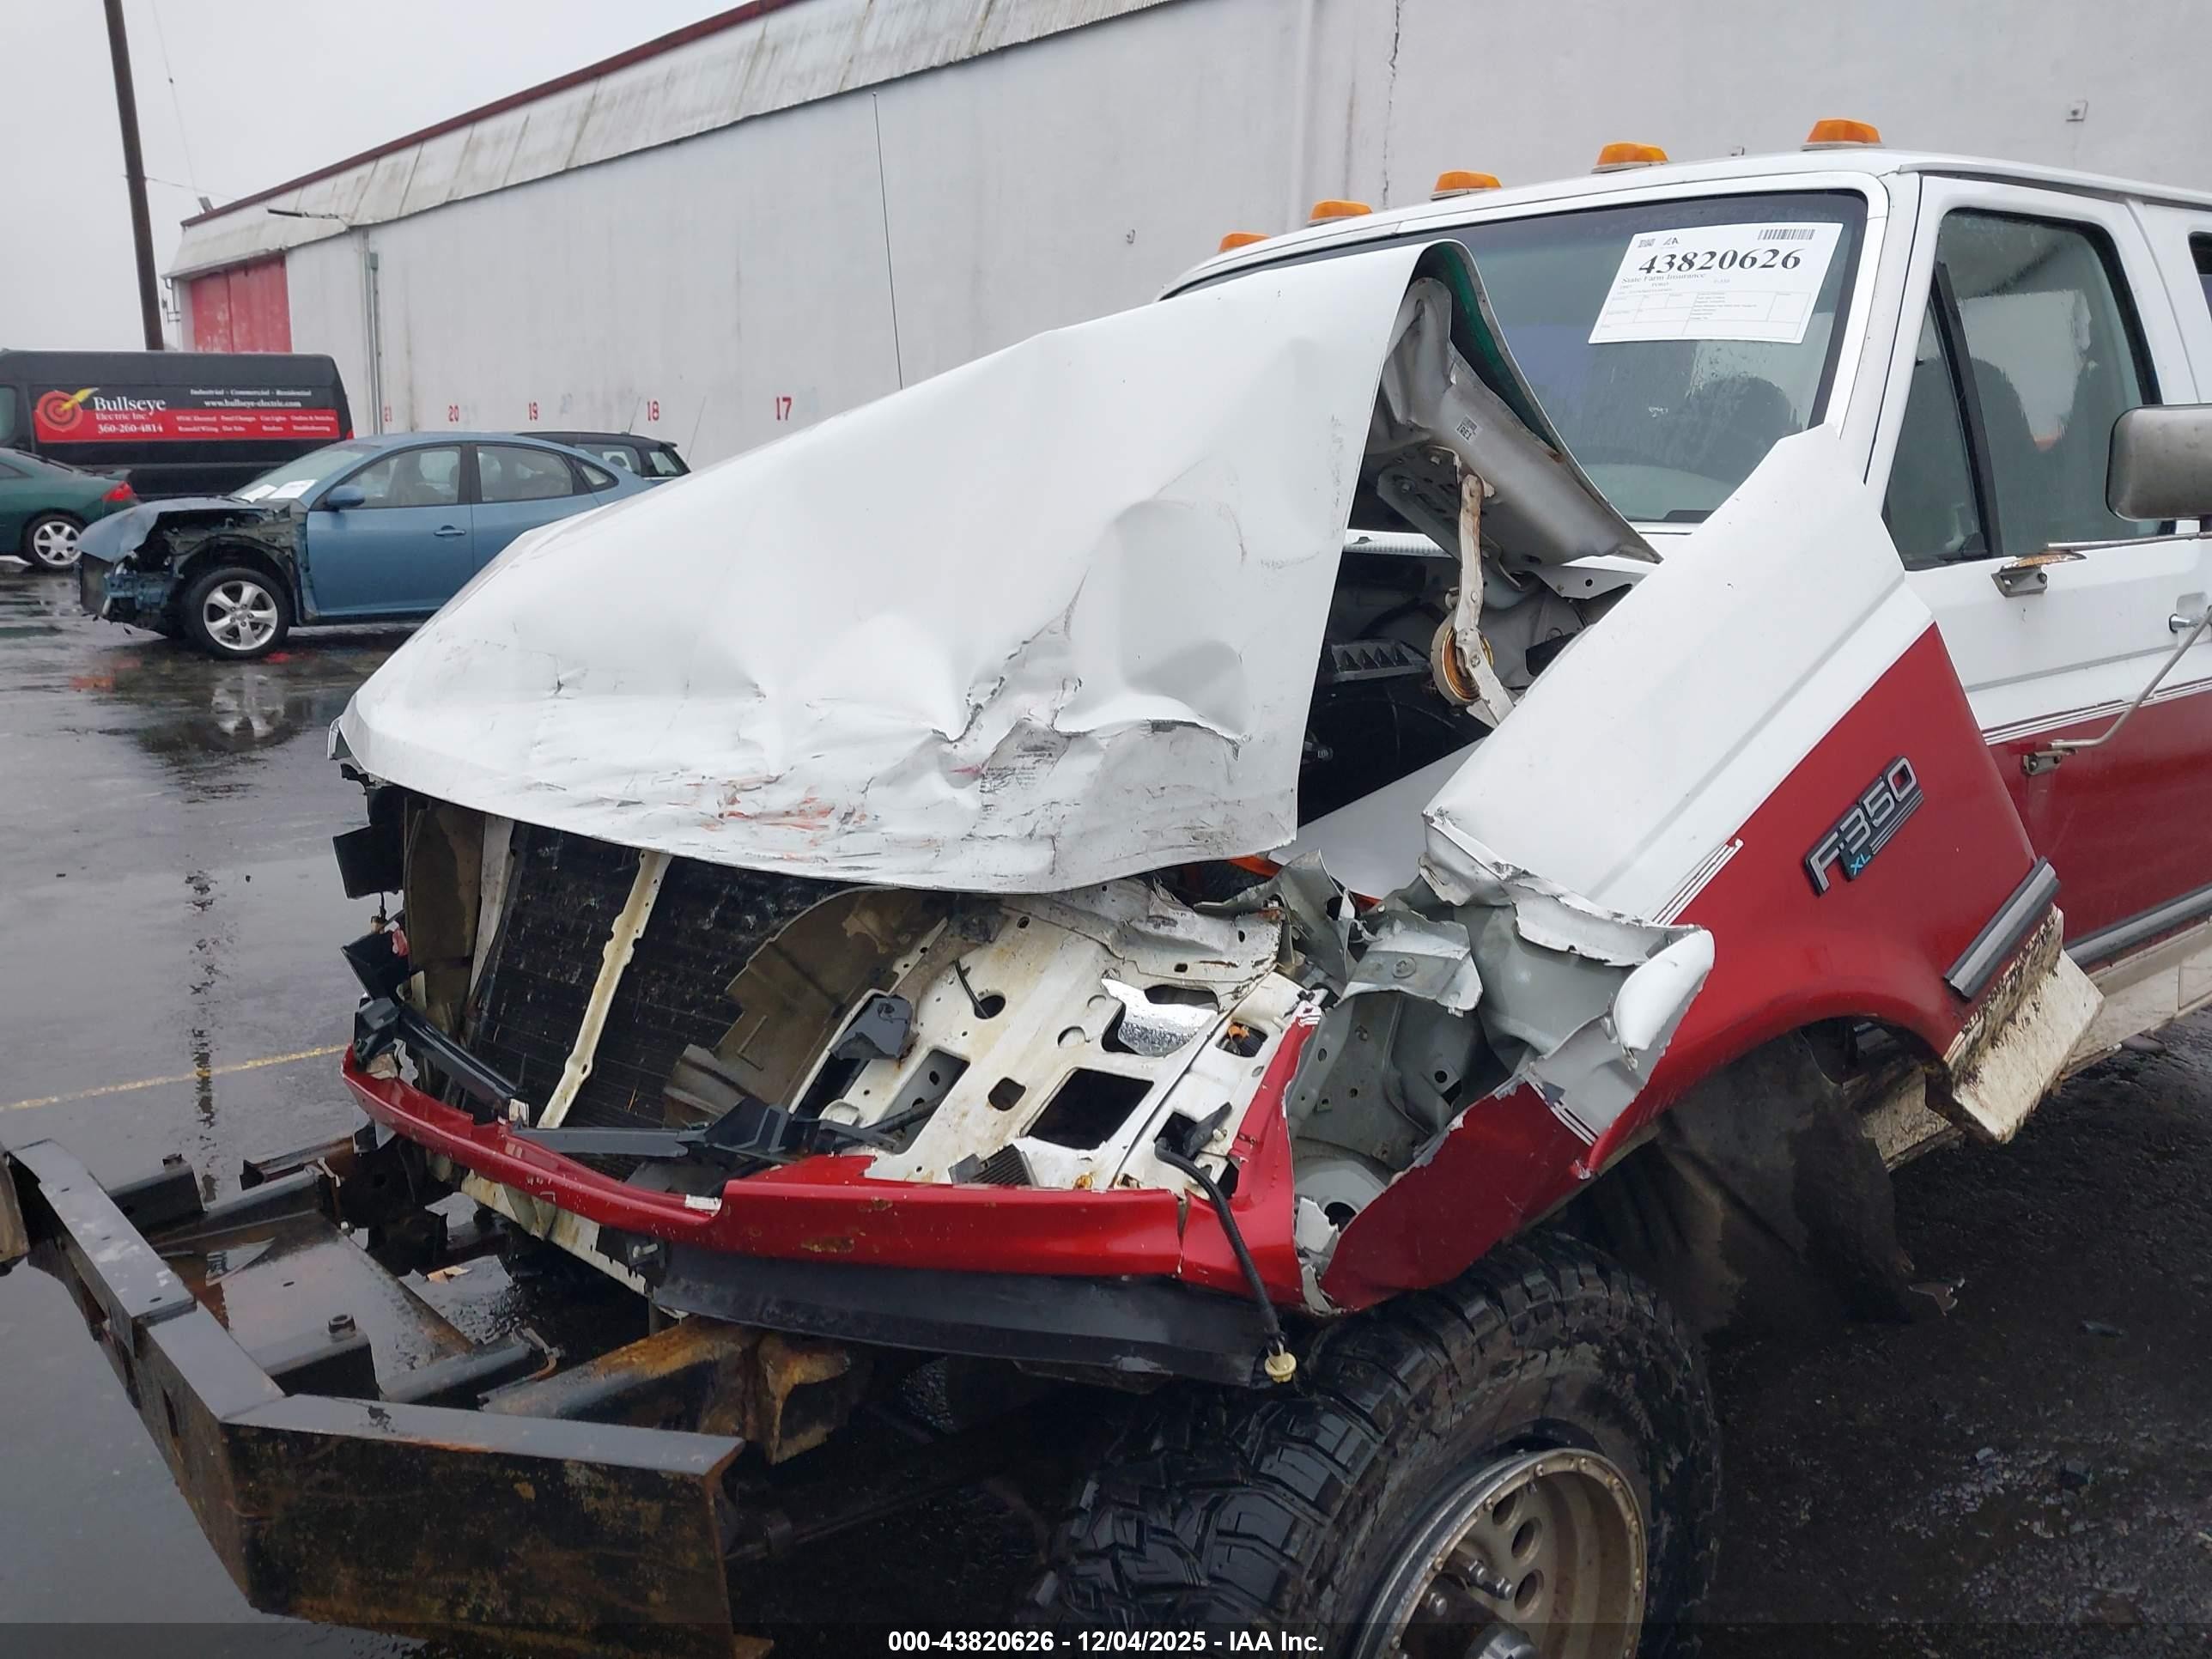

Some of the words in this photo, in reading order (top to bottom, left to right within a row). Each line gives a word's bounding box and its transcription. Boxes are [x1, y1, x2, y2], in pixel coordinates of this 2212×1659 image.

[1638, 247, 1805, 275] 43820626
[1621, 276, 1642, 284] State
[1644, 274, 1664, 283] Farm
[92, 395, 167, 416] Bullseye
[447, 404, 460, 422] 20
[528, 401, 538, 422] 19
[647, 400, 660, 422] 18
[775, 396, 793, 422] 17
[95, 412, 131, 421] Electric
[131, 412, 149, 421] Inc.
[97, 423, 164, 434] 360-260-4814
[1850, 853, 1872, 876] XL
